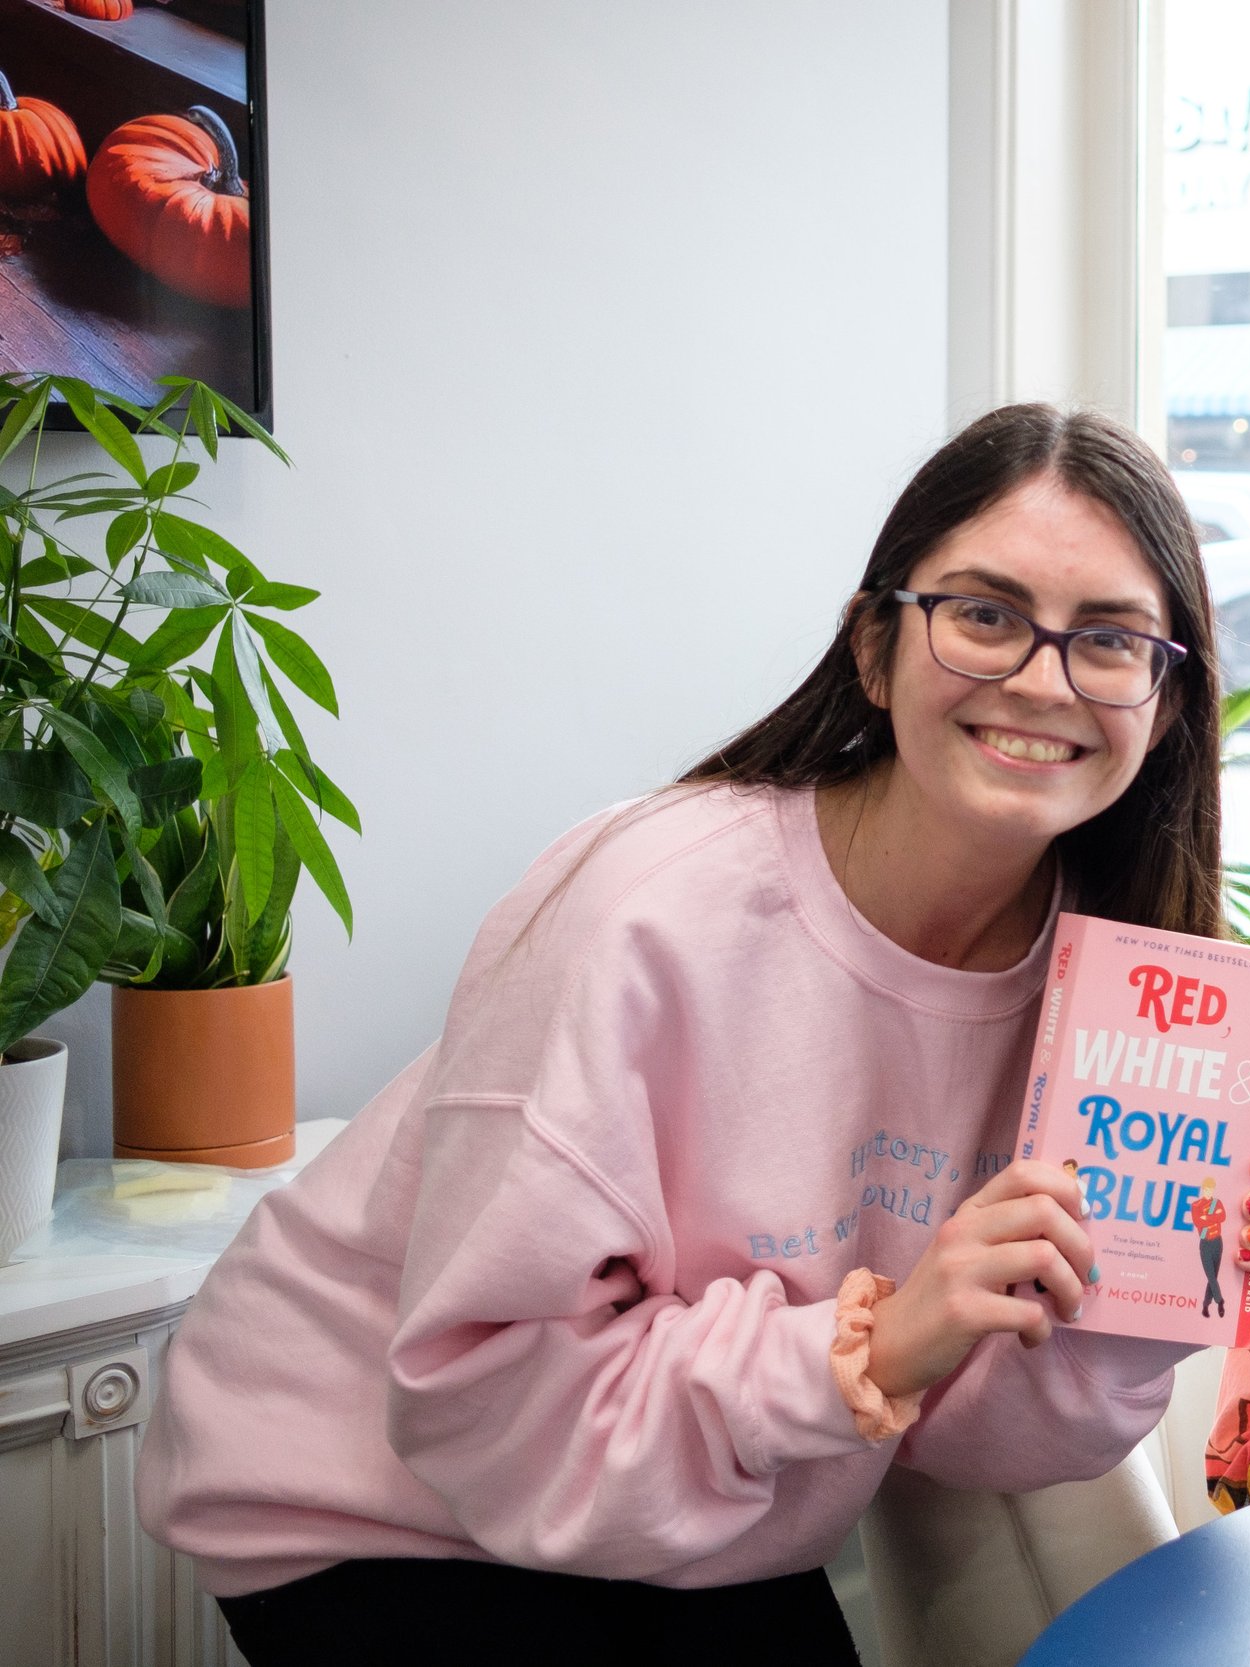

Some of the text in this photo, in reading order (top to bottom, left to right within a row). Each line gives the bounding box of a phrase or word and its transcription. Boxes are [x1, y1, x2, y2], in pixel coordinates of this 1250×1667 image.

[1115, 935, 1139, 945] NEW
[1143, 940, 1170, 952] YORK
[1175, 946, 1204, 958] TIMES
[1044, 987, 1063, 1045] WHITE
[1129, 965, 1231, 1038] RED,
[1073, 1028, 1227, 1100] WHITE
[1027, 1072, 1047, 1132] ROYAL
[1078, 1094, 1232, 1167] ROYAL
[1077, 1165, 1201, 1232] BLUE
[748, 1226, 823, 1259] Bet
[1102, 1246, 1126, 1257] always
[1113, 1234, 1128, 1243] True
[1129, 1237, 1144, 1246] love
[1108, 1287, 1198, 1309] McQUISTON
[1126, 1271, 1148, 1280] novel
